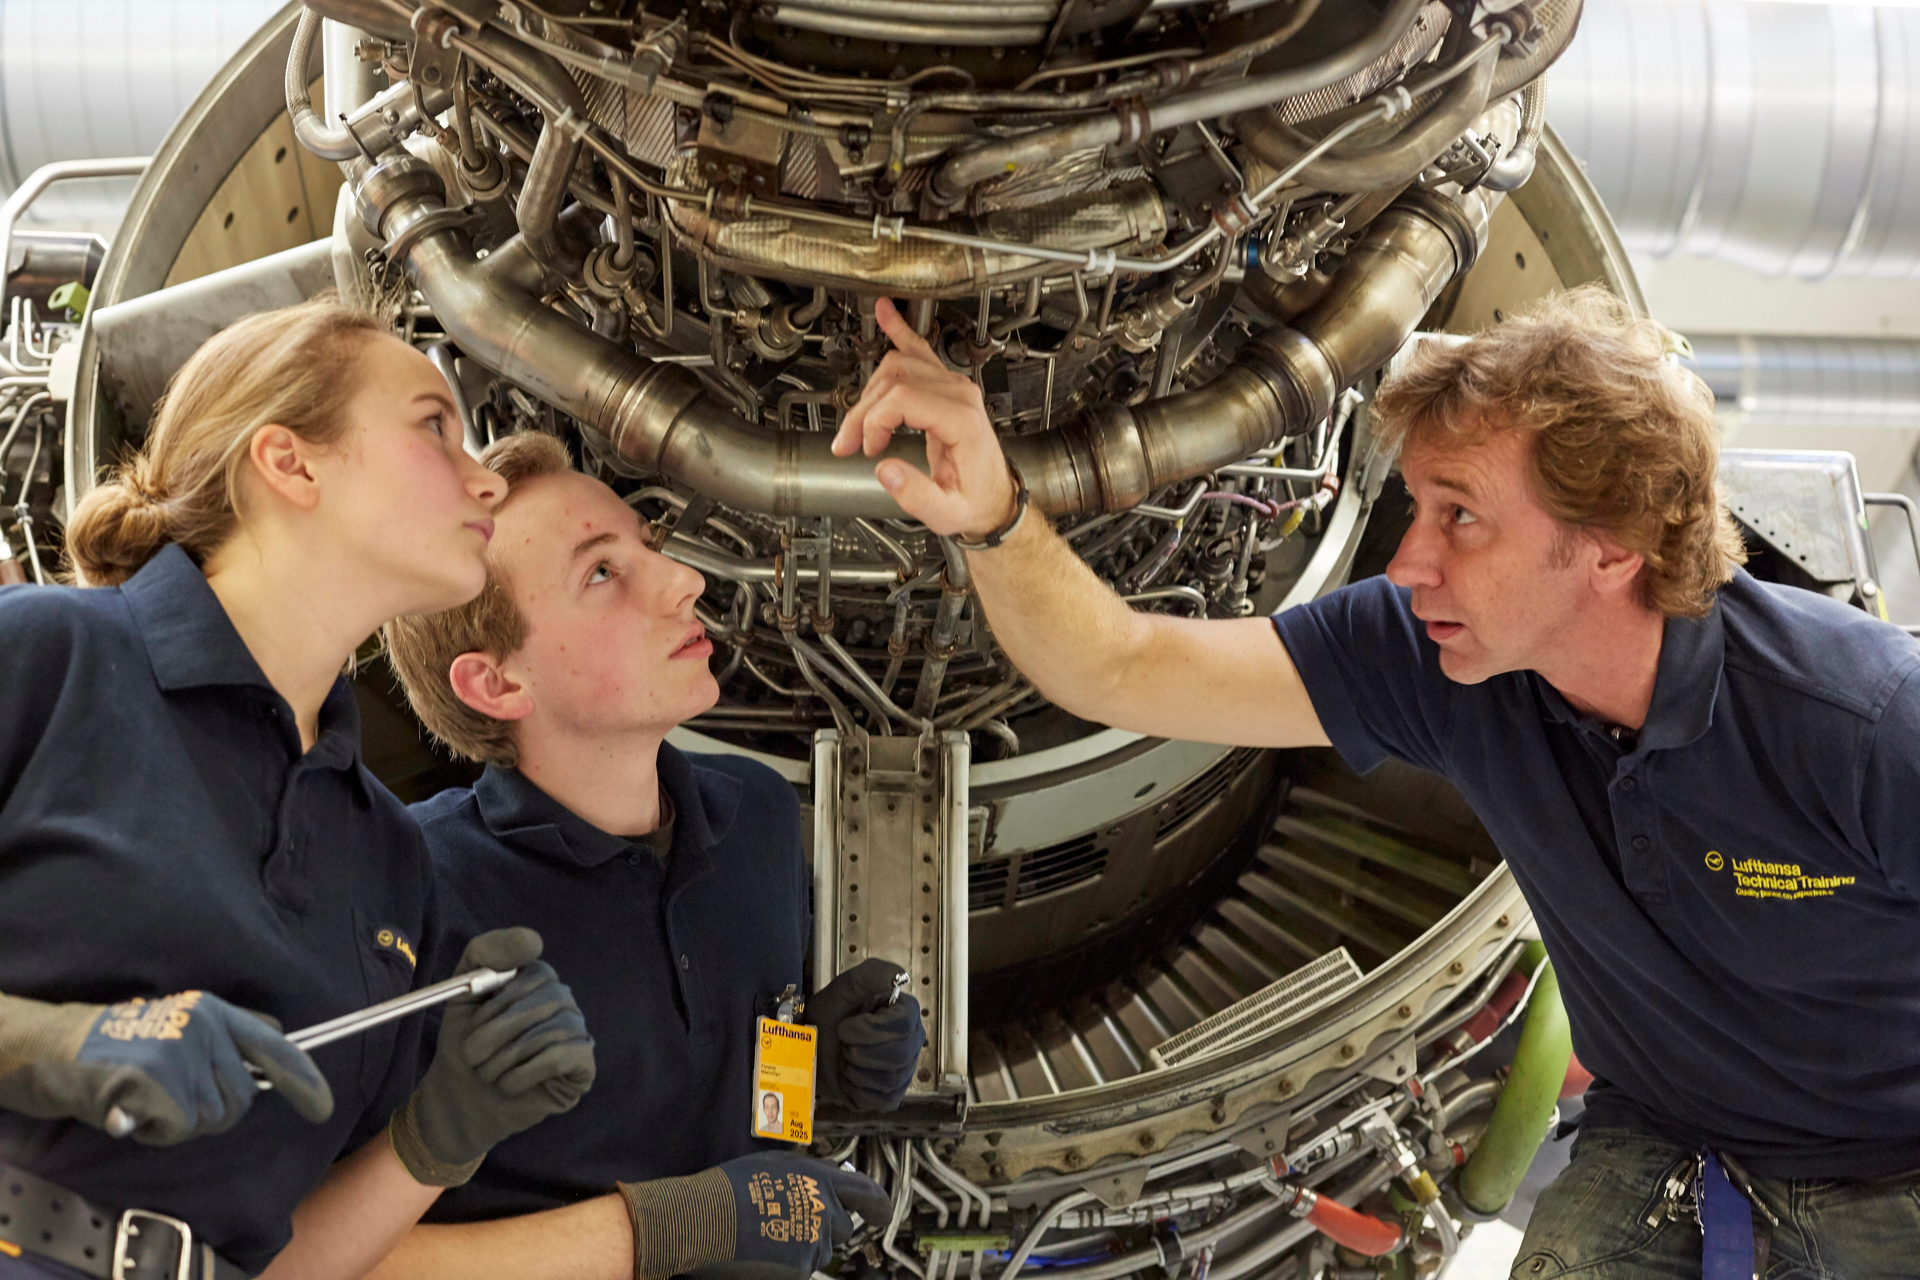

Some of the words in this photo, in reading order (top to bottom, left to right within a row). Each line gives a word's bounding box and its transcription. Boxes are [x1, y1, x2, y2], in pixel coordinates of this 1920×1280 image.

[1732, 858, 1801, 876] Lufthansa
[1733, 872, 1798, 890] Technical
[1798, 875, 1855, 889] Training
[762, 1022, 812, 1042] Lufthansa
[790, 1119, 804, 1129] Aug
[775, 1179, 785, 1192] 10
[803, 1175, 825, 1244] MAPA
